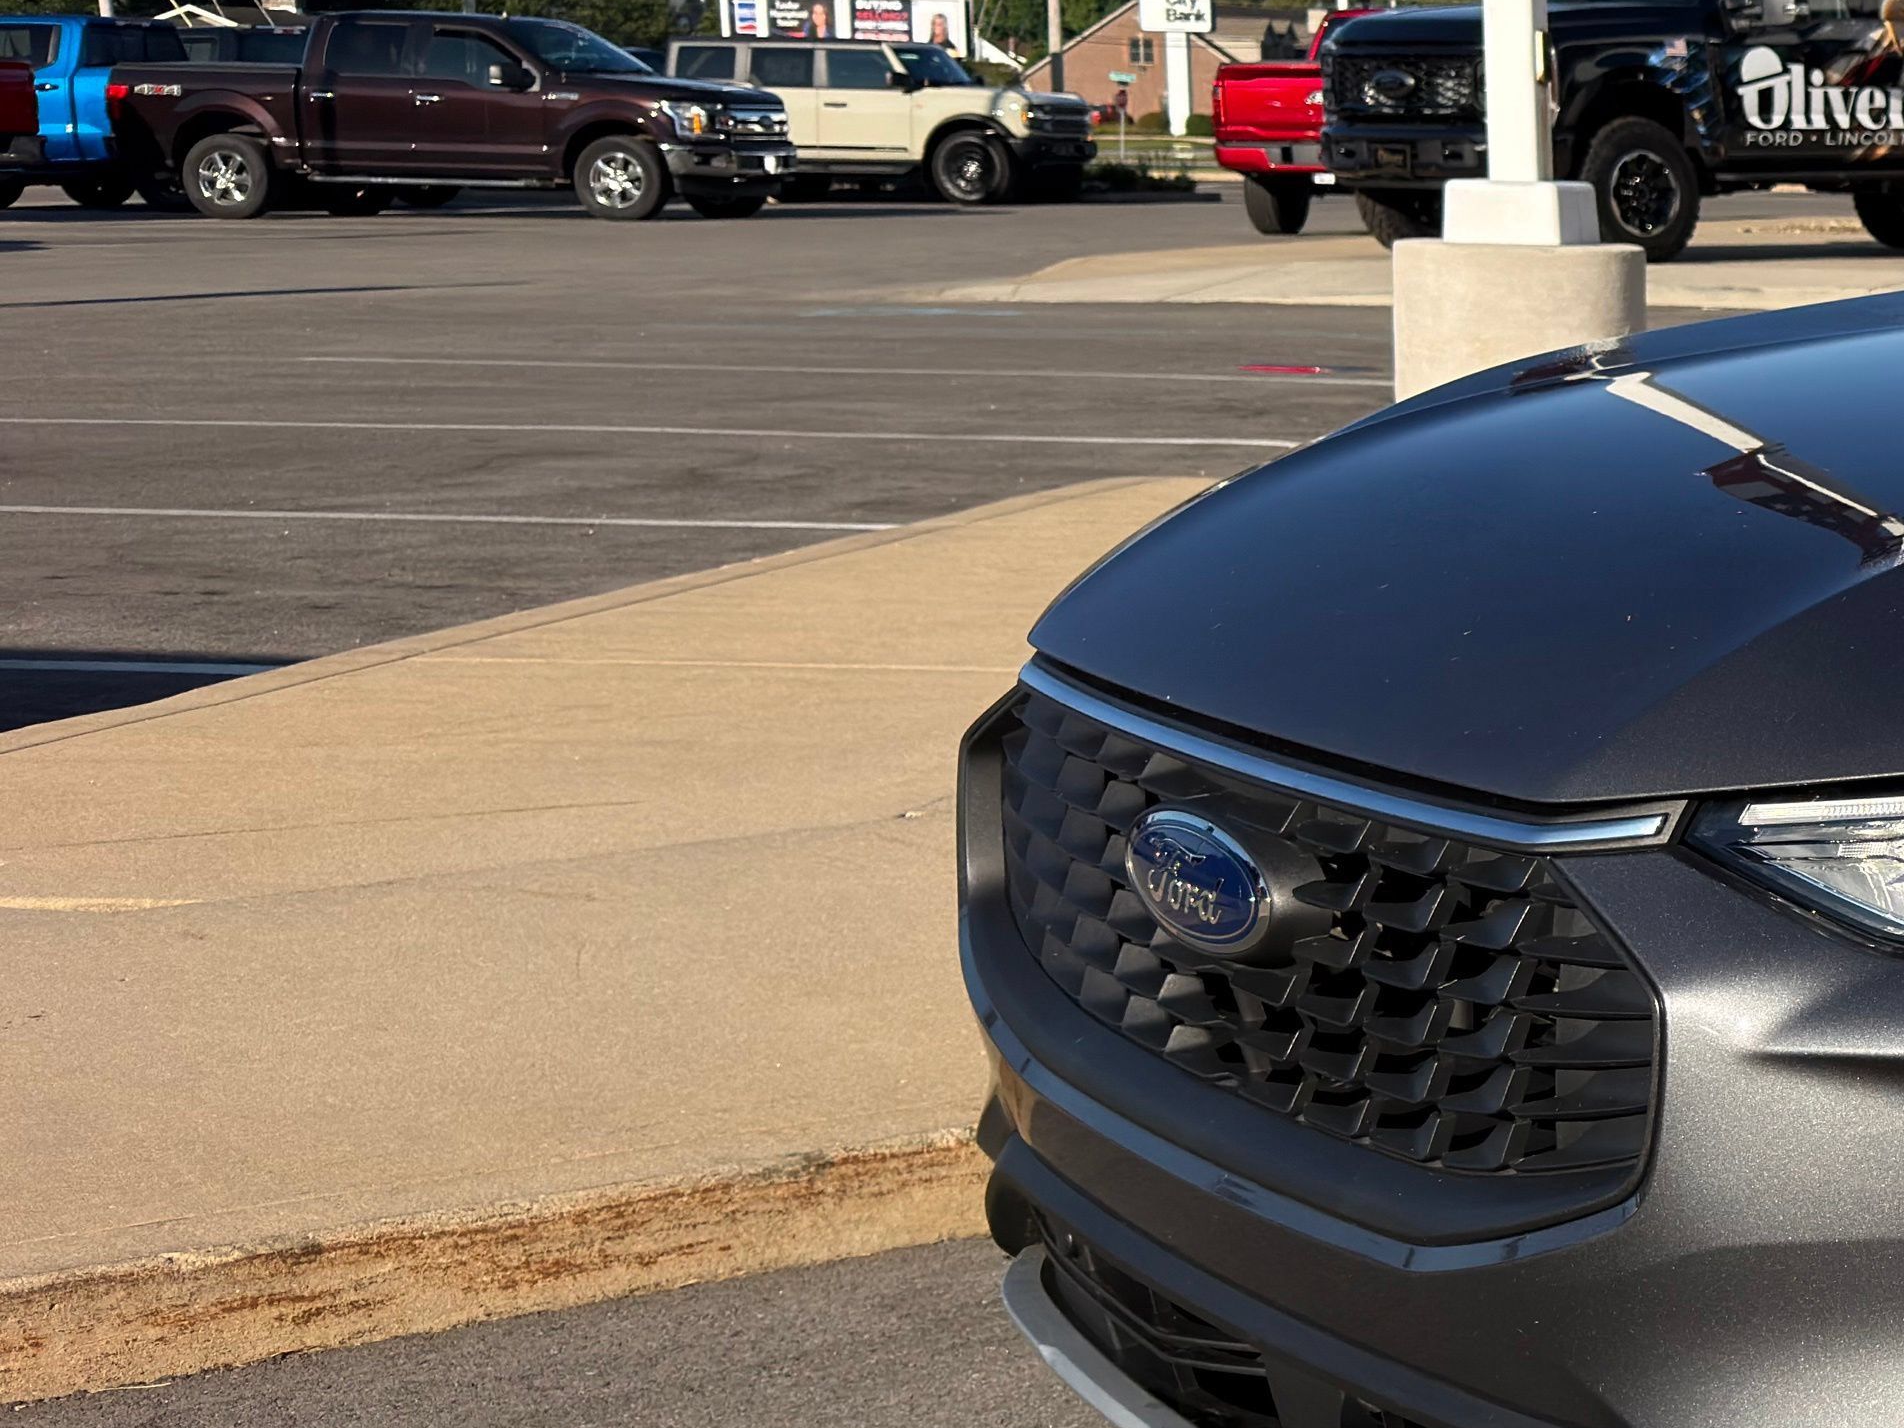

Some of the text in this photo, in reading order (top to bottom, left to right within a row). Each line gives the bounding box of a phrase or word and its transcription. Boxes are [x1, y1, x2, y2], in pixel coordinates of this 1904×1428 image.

[1166, 9, 1206, 22] Bank
[1746, 131, 1803, 147] FORD
[1148, 836, 1225, 925] Ford
